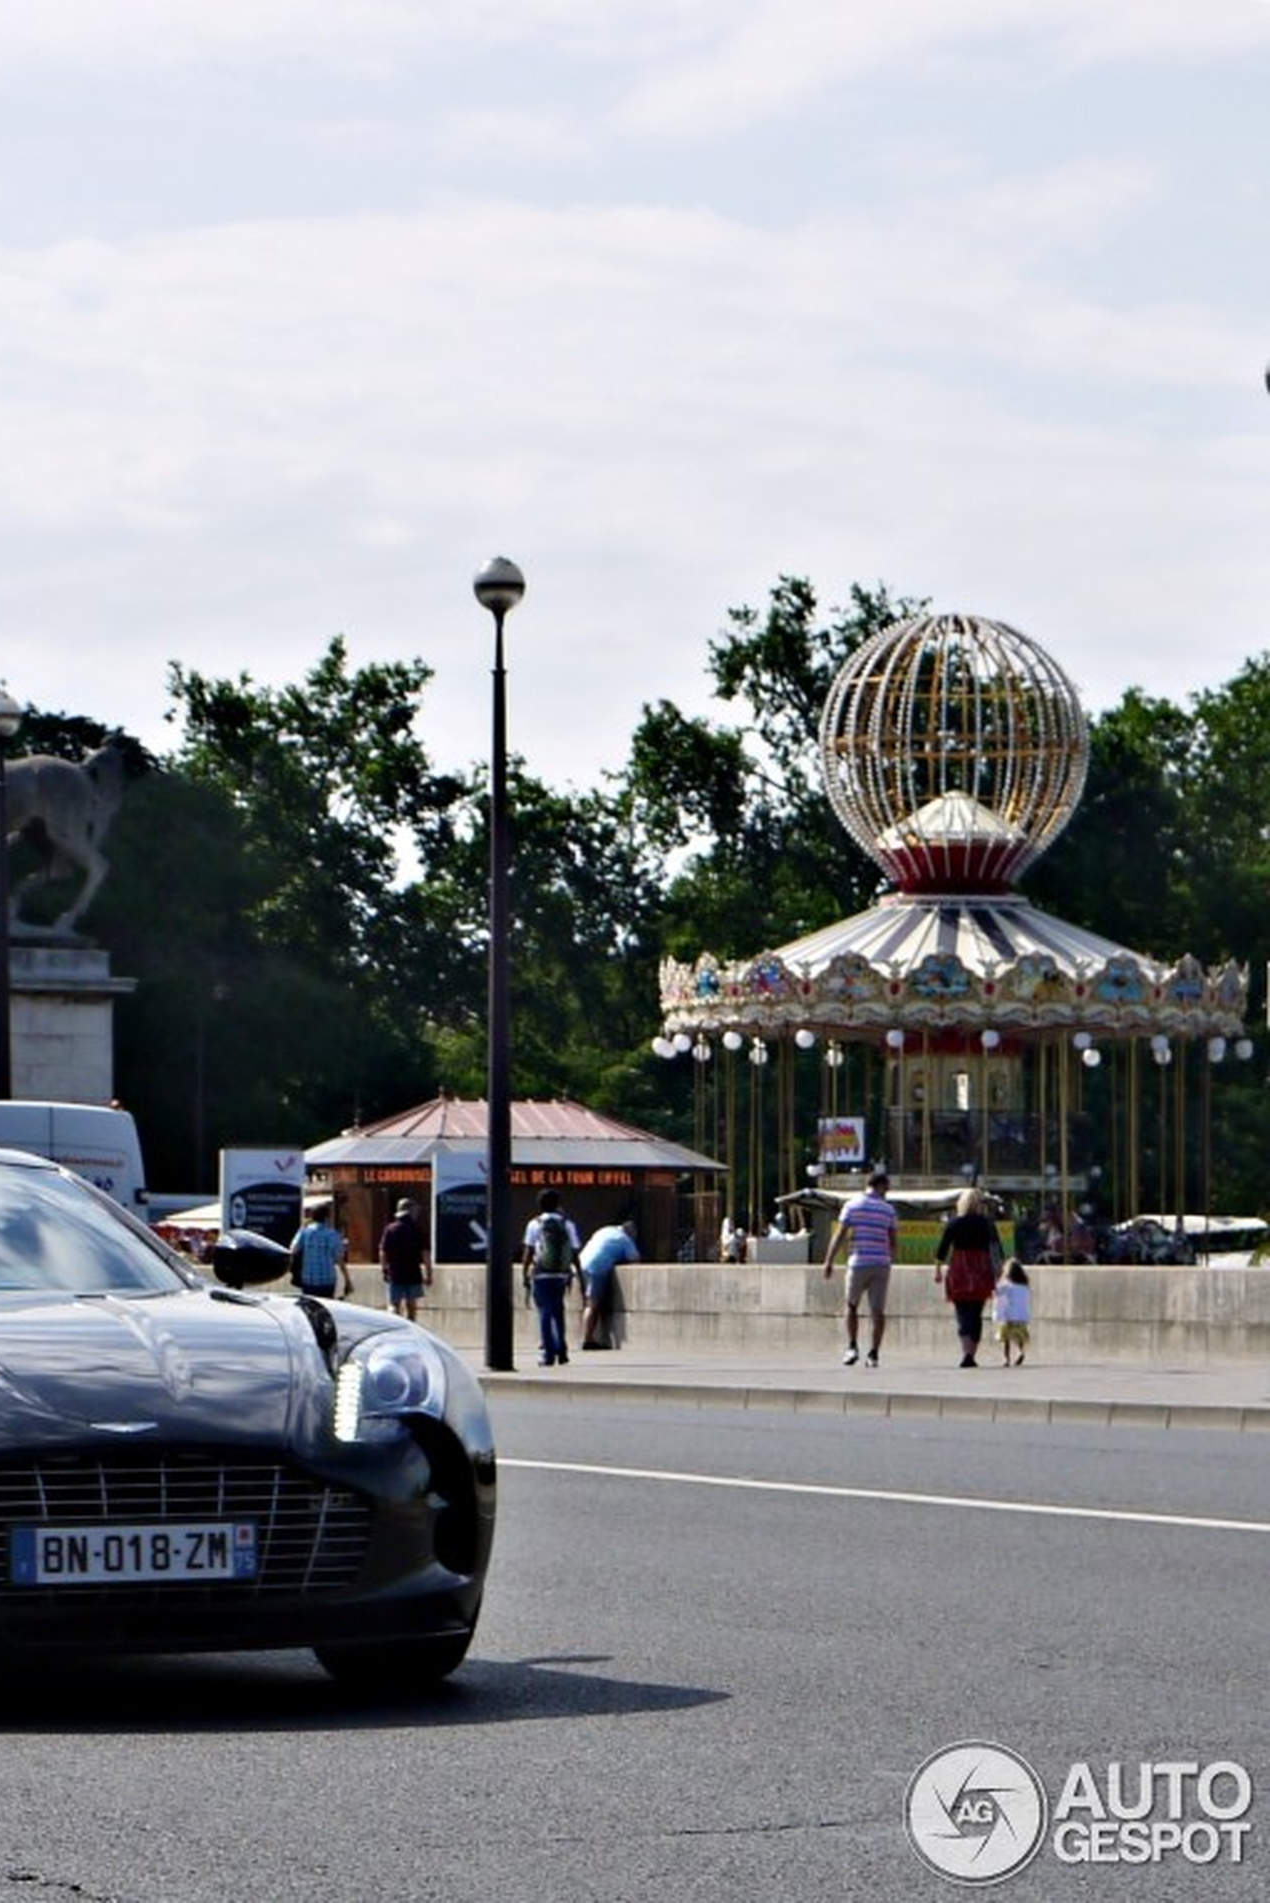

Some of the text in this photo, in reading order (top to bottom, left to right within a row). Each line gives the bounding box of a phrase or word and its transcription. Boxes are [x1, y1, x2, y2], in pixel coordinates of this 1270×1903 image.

[531, 1170, 546, 1185] DE
[548, 1170, 564, 1185] LA
[567, 1170, 595, 1185] TOUR
[43, 1532, 228, 1574] BN-018-ZM
[236, 1551, 256, 1570] 75
